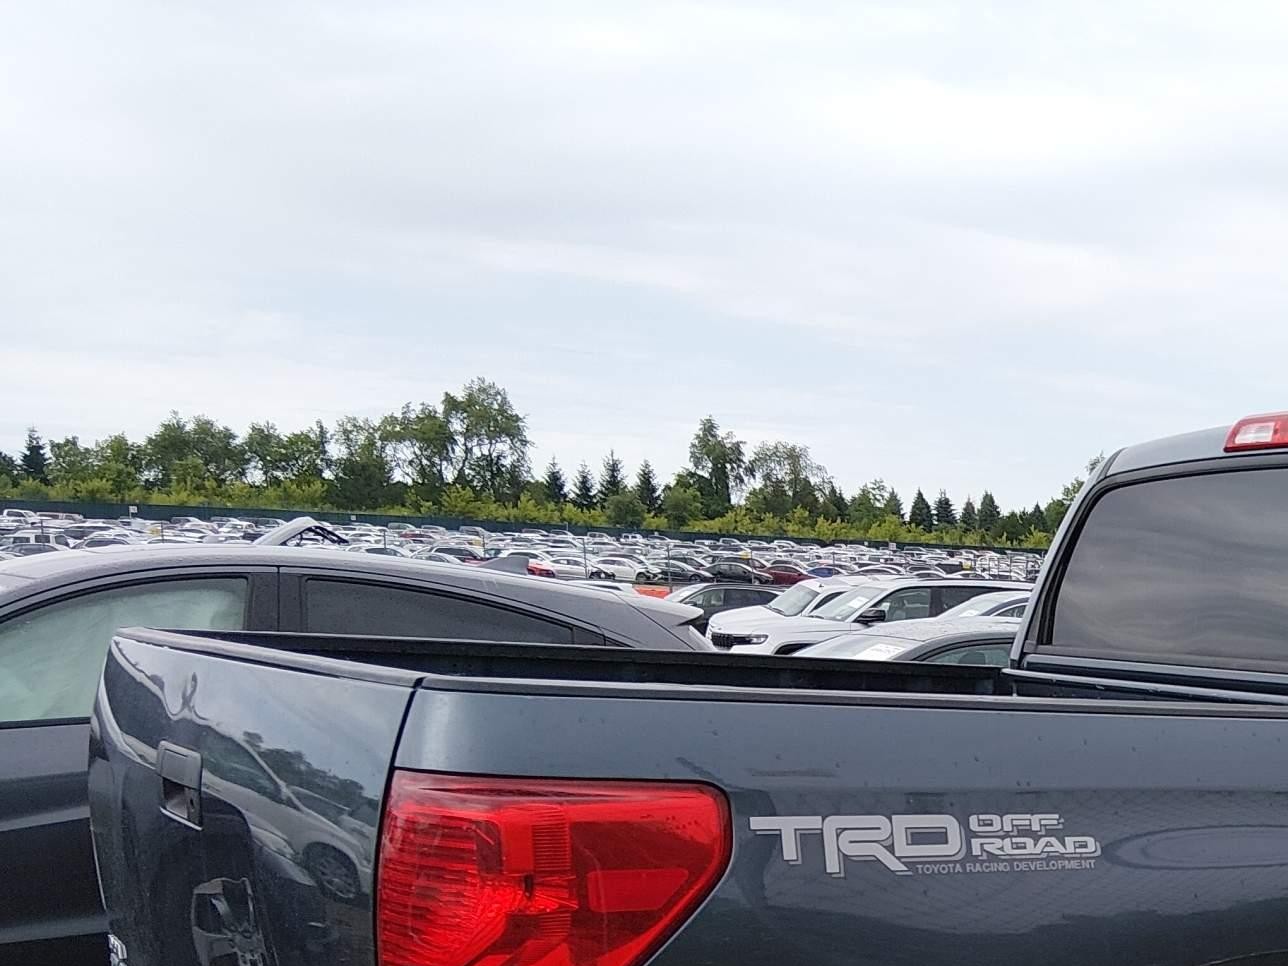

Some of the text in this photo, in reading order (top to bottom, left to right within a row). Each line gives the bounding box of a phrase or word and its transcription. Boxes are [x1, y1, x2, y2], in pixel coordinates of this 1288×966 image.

[968, 814, 1064, 836] OFF
[749, 814, 965, 878] TRD
[970, 836, 1101, 860] ROAD
[916, 859, 1096, 875] TOYOTA RACING DEVELOPMENT
